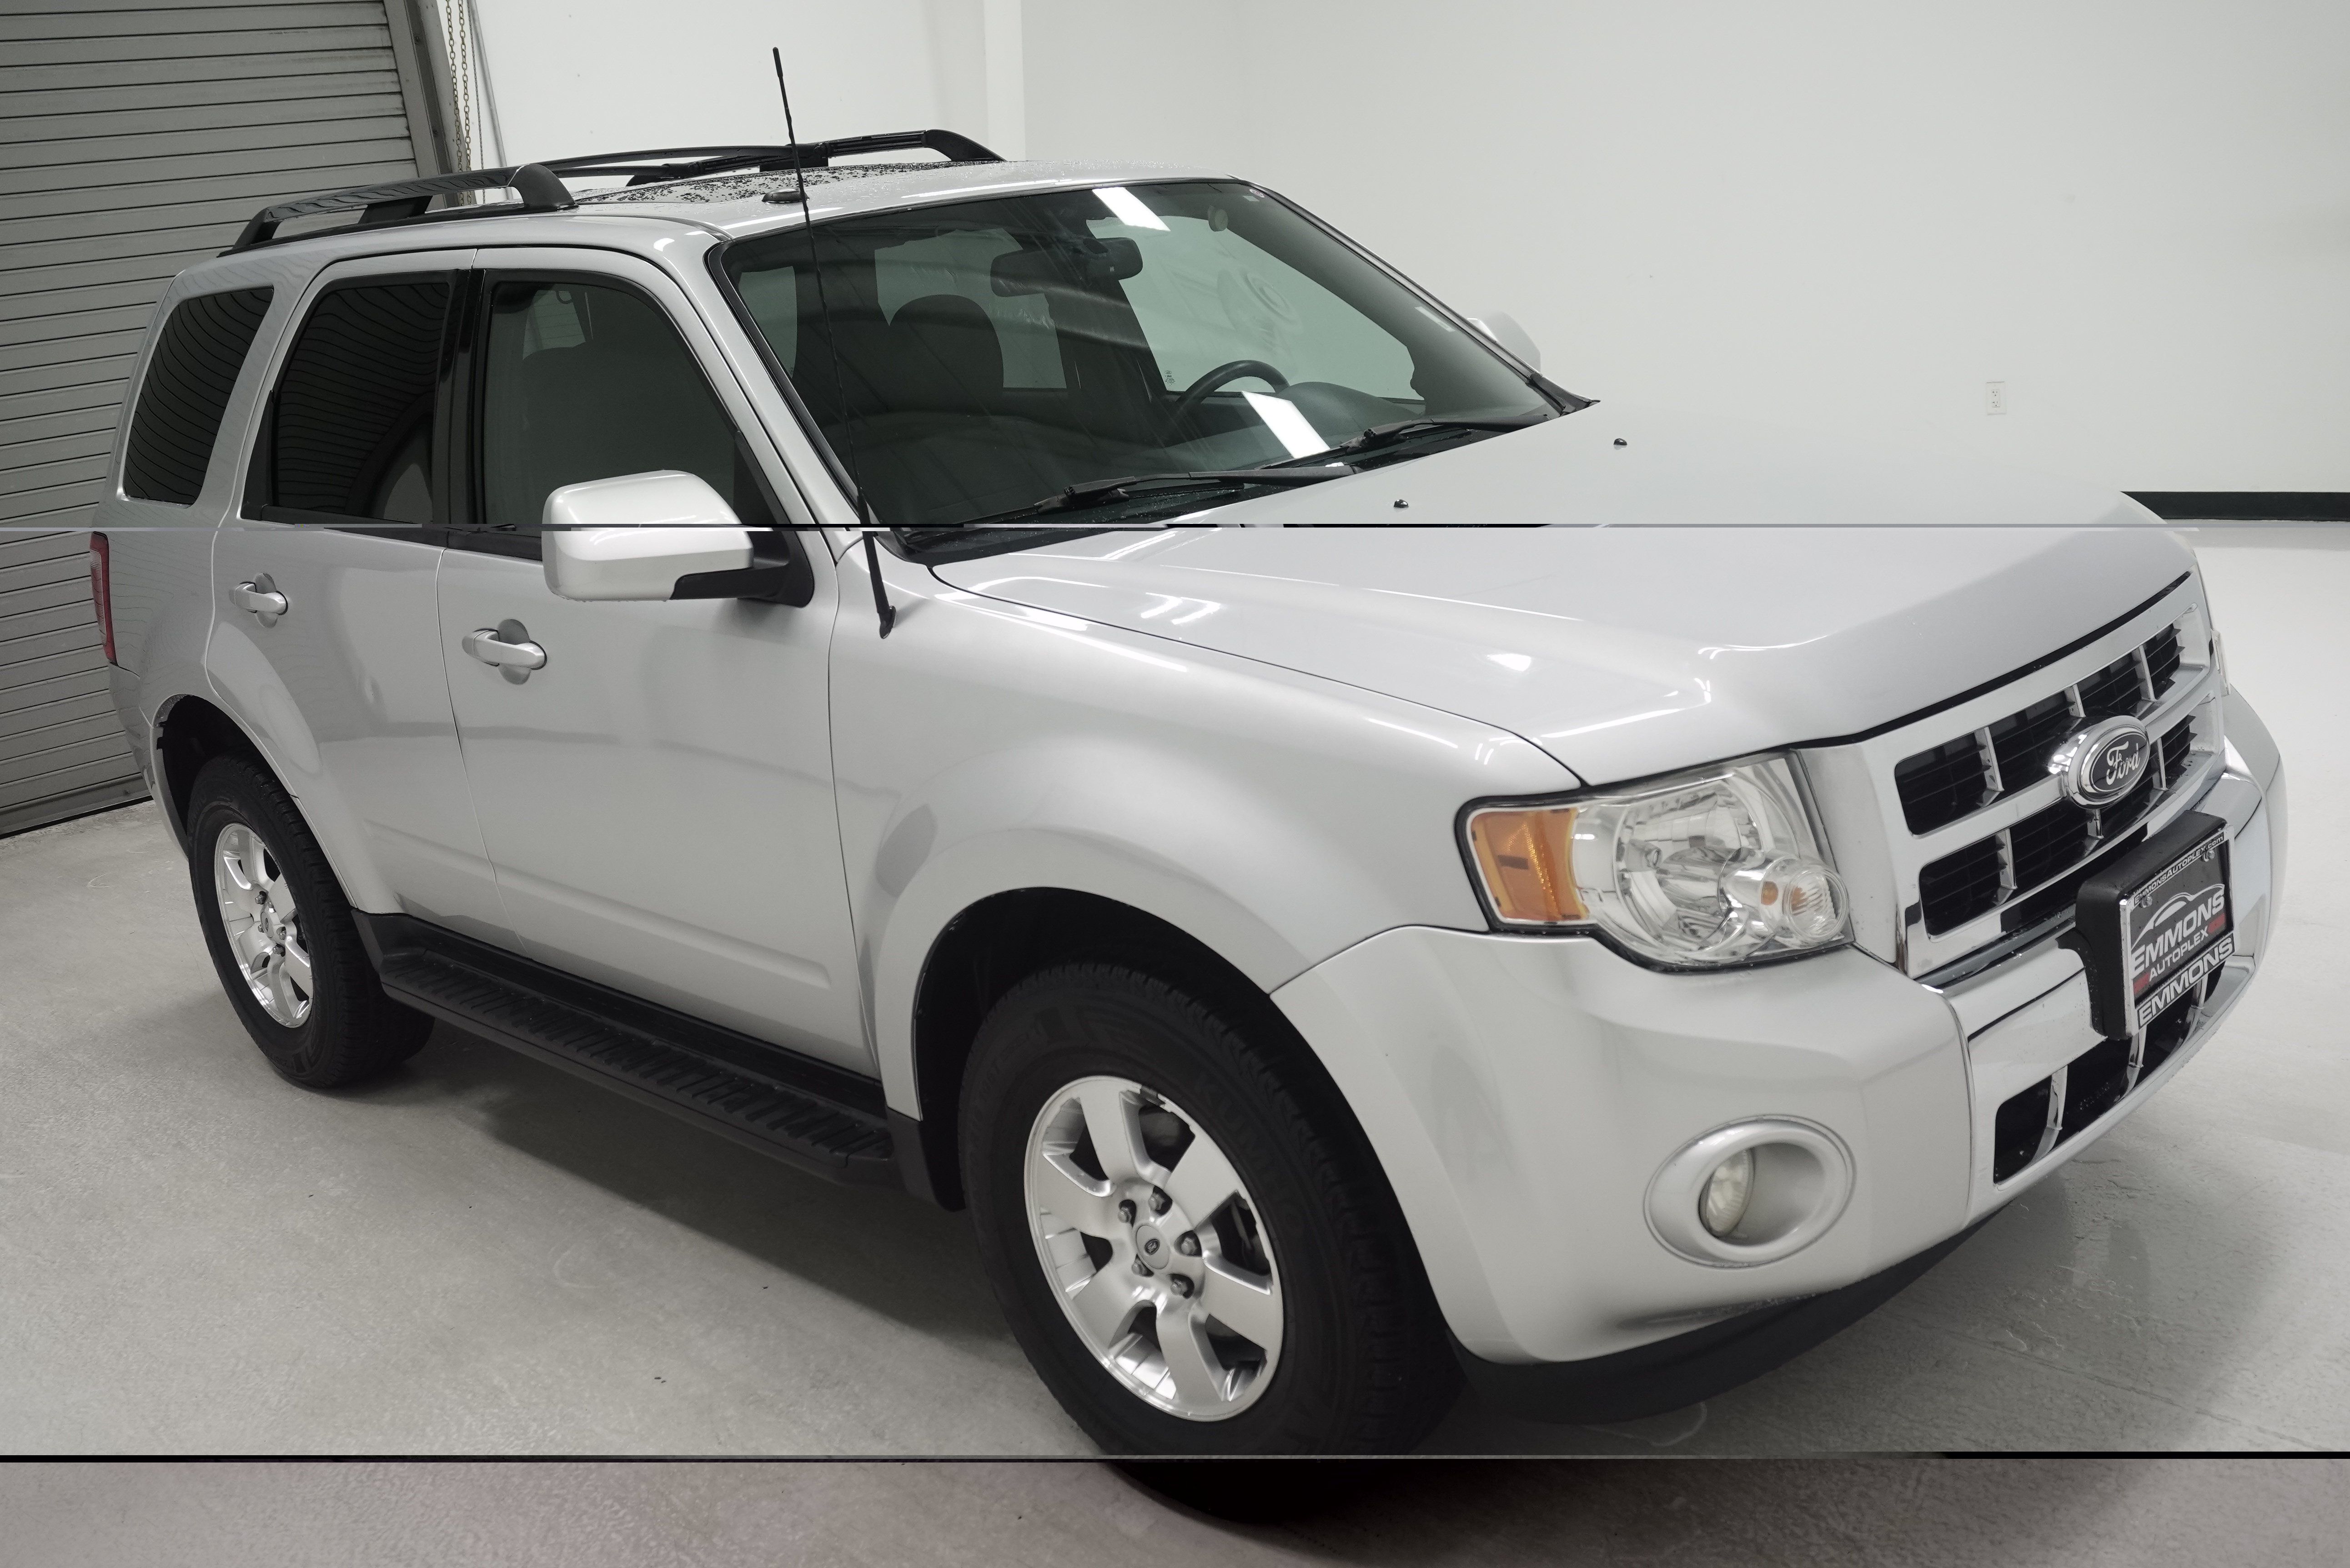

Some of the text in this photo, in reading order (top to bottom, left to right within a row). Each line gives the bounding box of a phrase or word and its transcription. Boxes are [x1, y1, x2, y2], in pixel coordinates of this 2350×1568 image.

[2106, 741, 2141, 785] Ford
[2134, 834, 2224, 904] EMMONSAUTOPLEX.com
[2131, 889, 2225, 977] EMMONS
[2149, 925, 2209, 982] AUTOPLEX
[2139, 937, 2233, 1027] EMMONS
